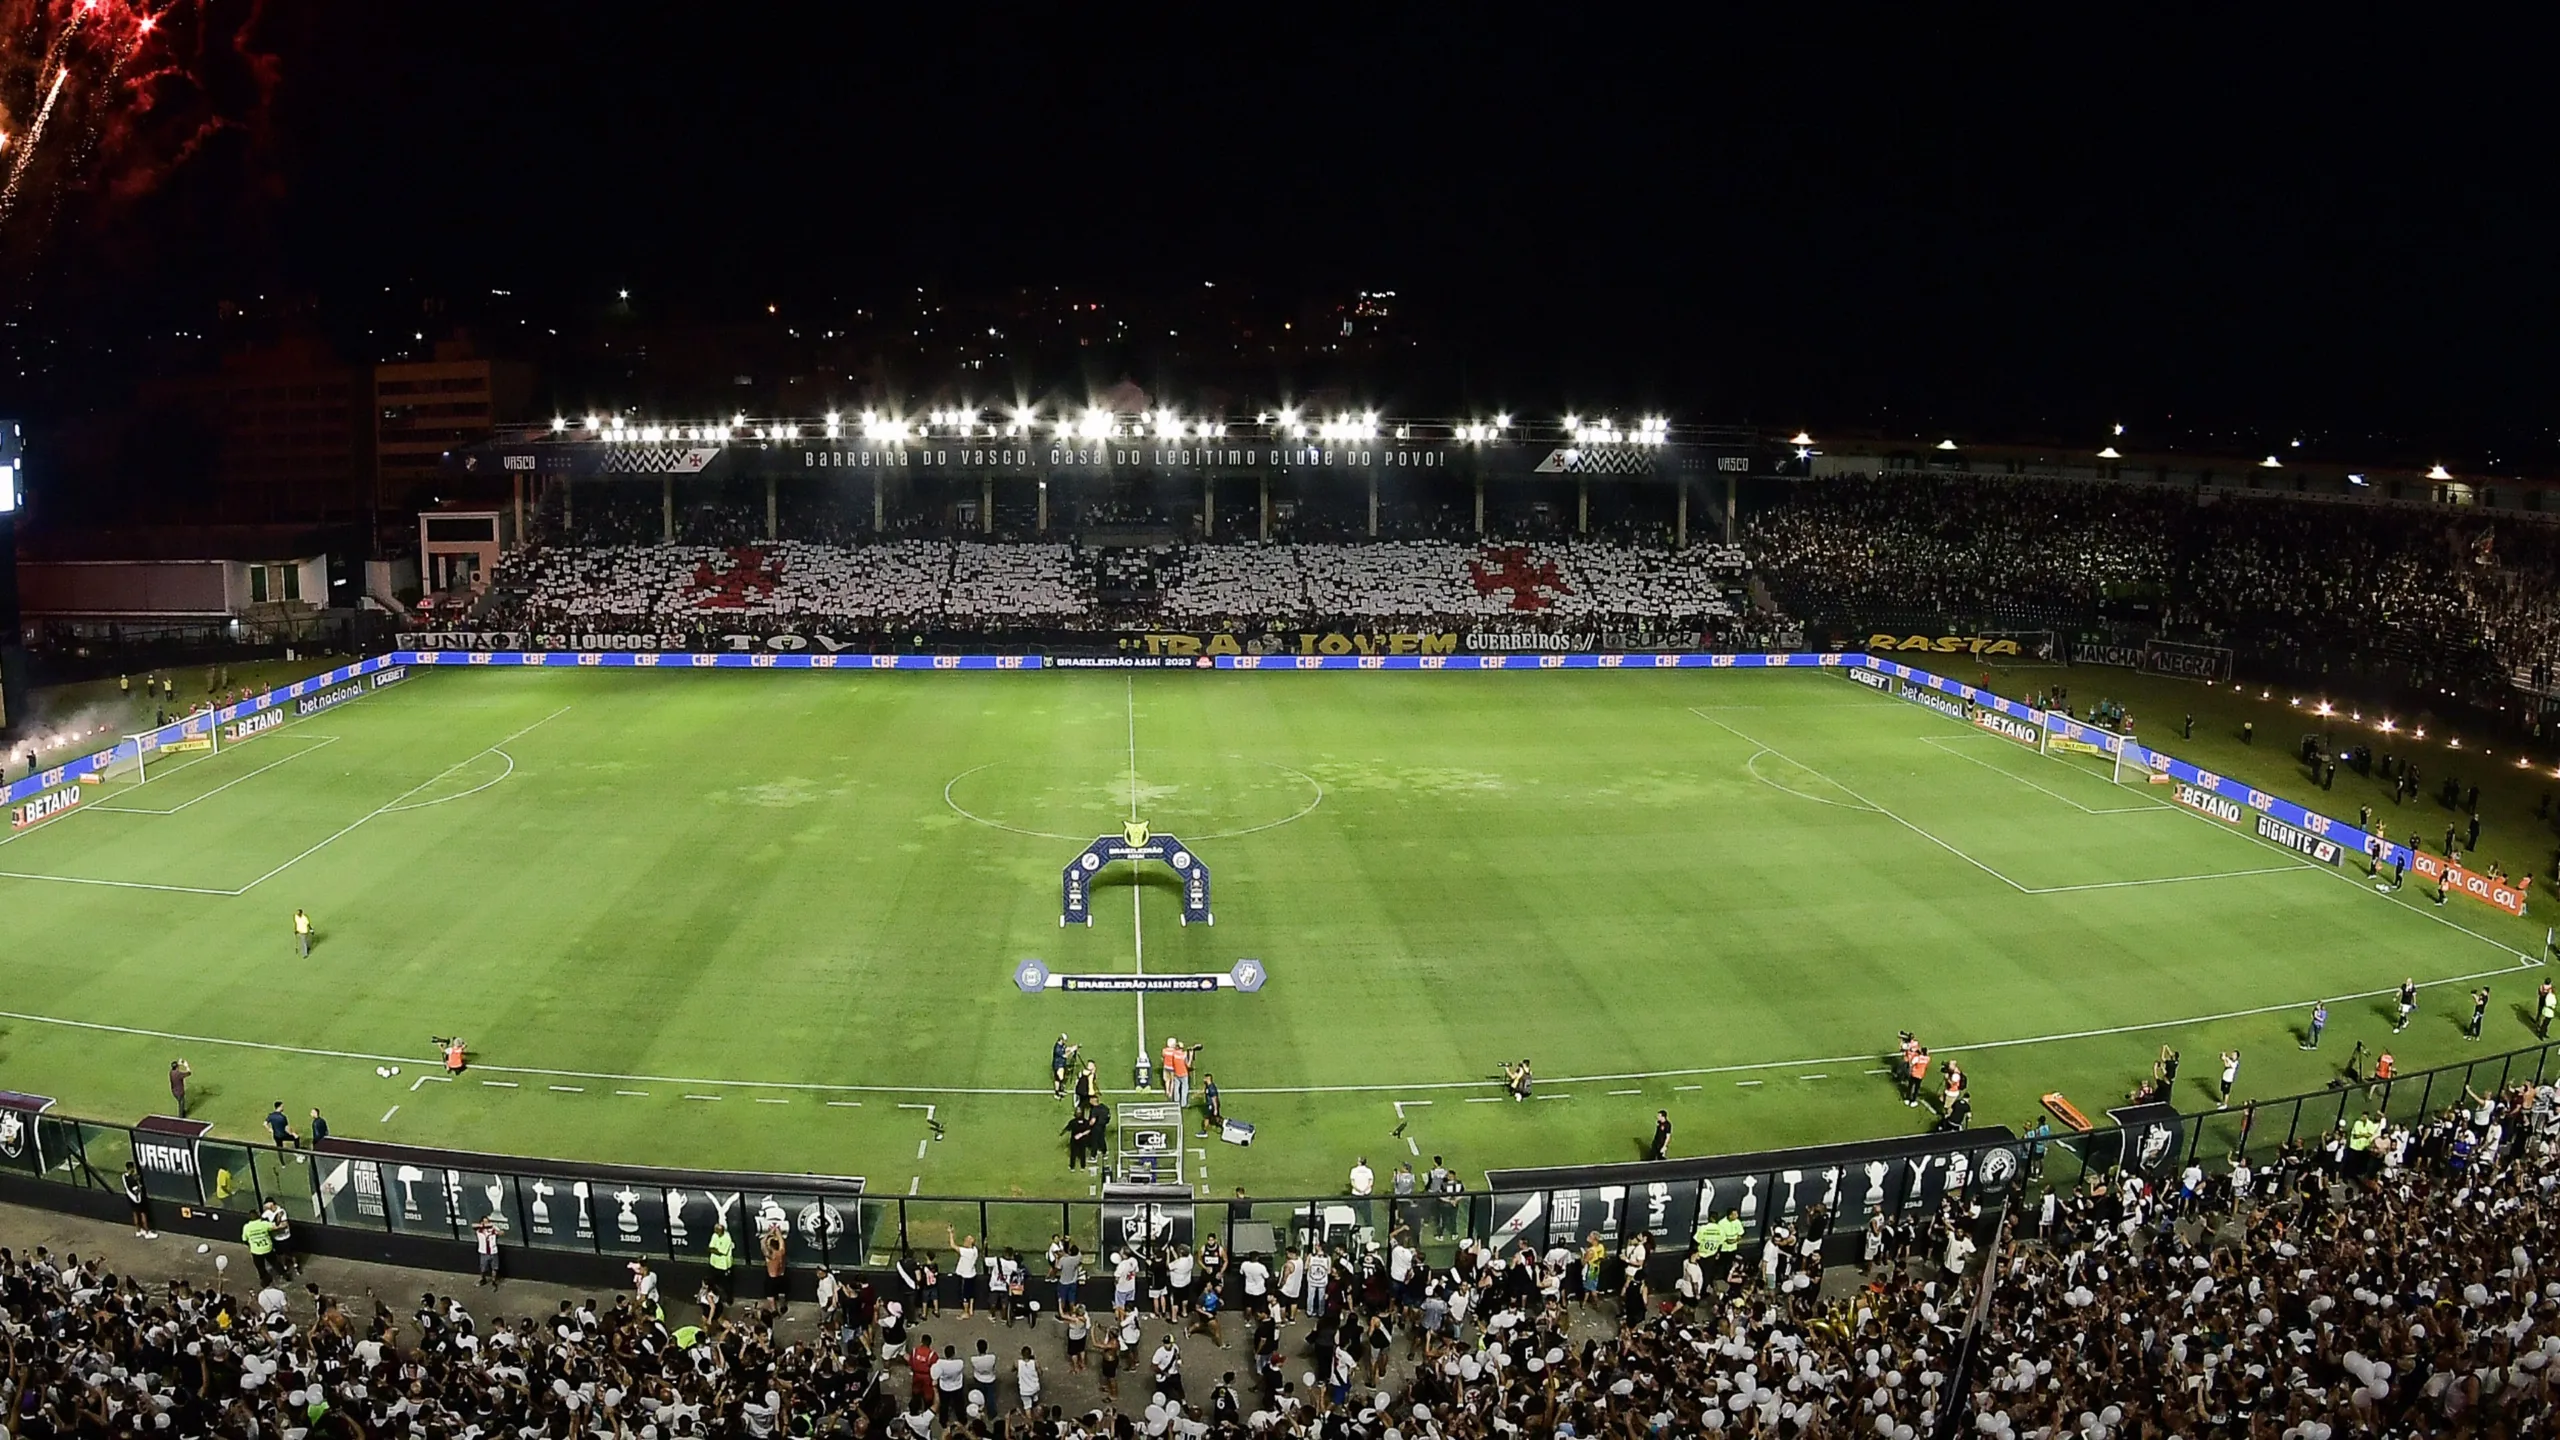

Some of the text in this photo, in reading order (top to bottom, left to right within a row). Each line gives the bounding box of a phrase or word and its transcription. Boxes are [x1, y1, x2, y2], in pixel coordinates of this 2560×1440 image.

[504, 456, 535, 470] VASCO
[924, 450, 946, 465] DO
[1118, 450, 1141, 466] DO
[1348, 451, 1370, 466] DO
[1385, 451, 1444, 467] POVO!
[1718, 458, 1748, 471] VASCO
[571, 634, 657, 650] LOUCOS
[1466, 633, 1570, 651] GUERREIROS
[1869, 634, 2018, 656] RASTA
[417, 653, 1023, 668] CBF CBF CBF CBF CBF CBF CBF CBF CBF CBF CBF
[1057, 656, 1133, 667] BRASILEIRÃO
[1164, 658, 1191, 668] 2023
[1234, 654, 1842, 669] CBF CBF CBF CBF CBF CBF CBF CBF CBF CBF CBF
[2071, 643, 2142, 668] MANCHA
[2157, 652, 2215, 676] NEGRA
[300, 680, 363, 715] betnacional
[1901, 681, 1963, 718] betnacional
[42, 766, 65, 789] CBF
[92, 748, 115, 770] CBF
[221, 705, 237, 723] CBF
[257, 693, 272, 710] CBF
[290, 681, 304, 698] CBF
[320, 671, 333, 687] CBF
[348, 661, 362, 677] CBF
[378, 652, 391, 668] CBF
[238, 707, 284, 737] BETANO
[1983, 711, 2037, 744] BETANO
[1866, 656, 1880, 670] CBF
[1896, 664, 1911, 680] CBF
[1928, 674, 1943, 690] CBF
[1994, 695, 2010, 713] CBF
[2027, 707, 2044, 727] CBF
[2064, 722, 2082, 742] CBF
[2150, 751, 2170, 774] CBF
[2197, 769, 2218, 791] CBF
[2247, 787, 2272, 814] CBF
[2303, 810, 2329, 836] CBF
[26, 784, 81, 824] BETANO
[2182, 784, 2241, 824] BETANO
[2257, 816, 2313, 855] GIGANTE
[2415, 856, 2438, 878] GOL
[2466, 876, 2489, 899] GOL
[2492, 889, 2517, 911] GOL
[1077, 980, 1146, 989] BRASILEIRÃO
[1174, 981, 1199, 989] 2023
[136, 1141, 195, 1176] VASCO
[1216, 1397, 1225, 1410] 6
